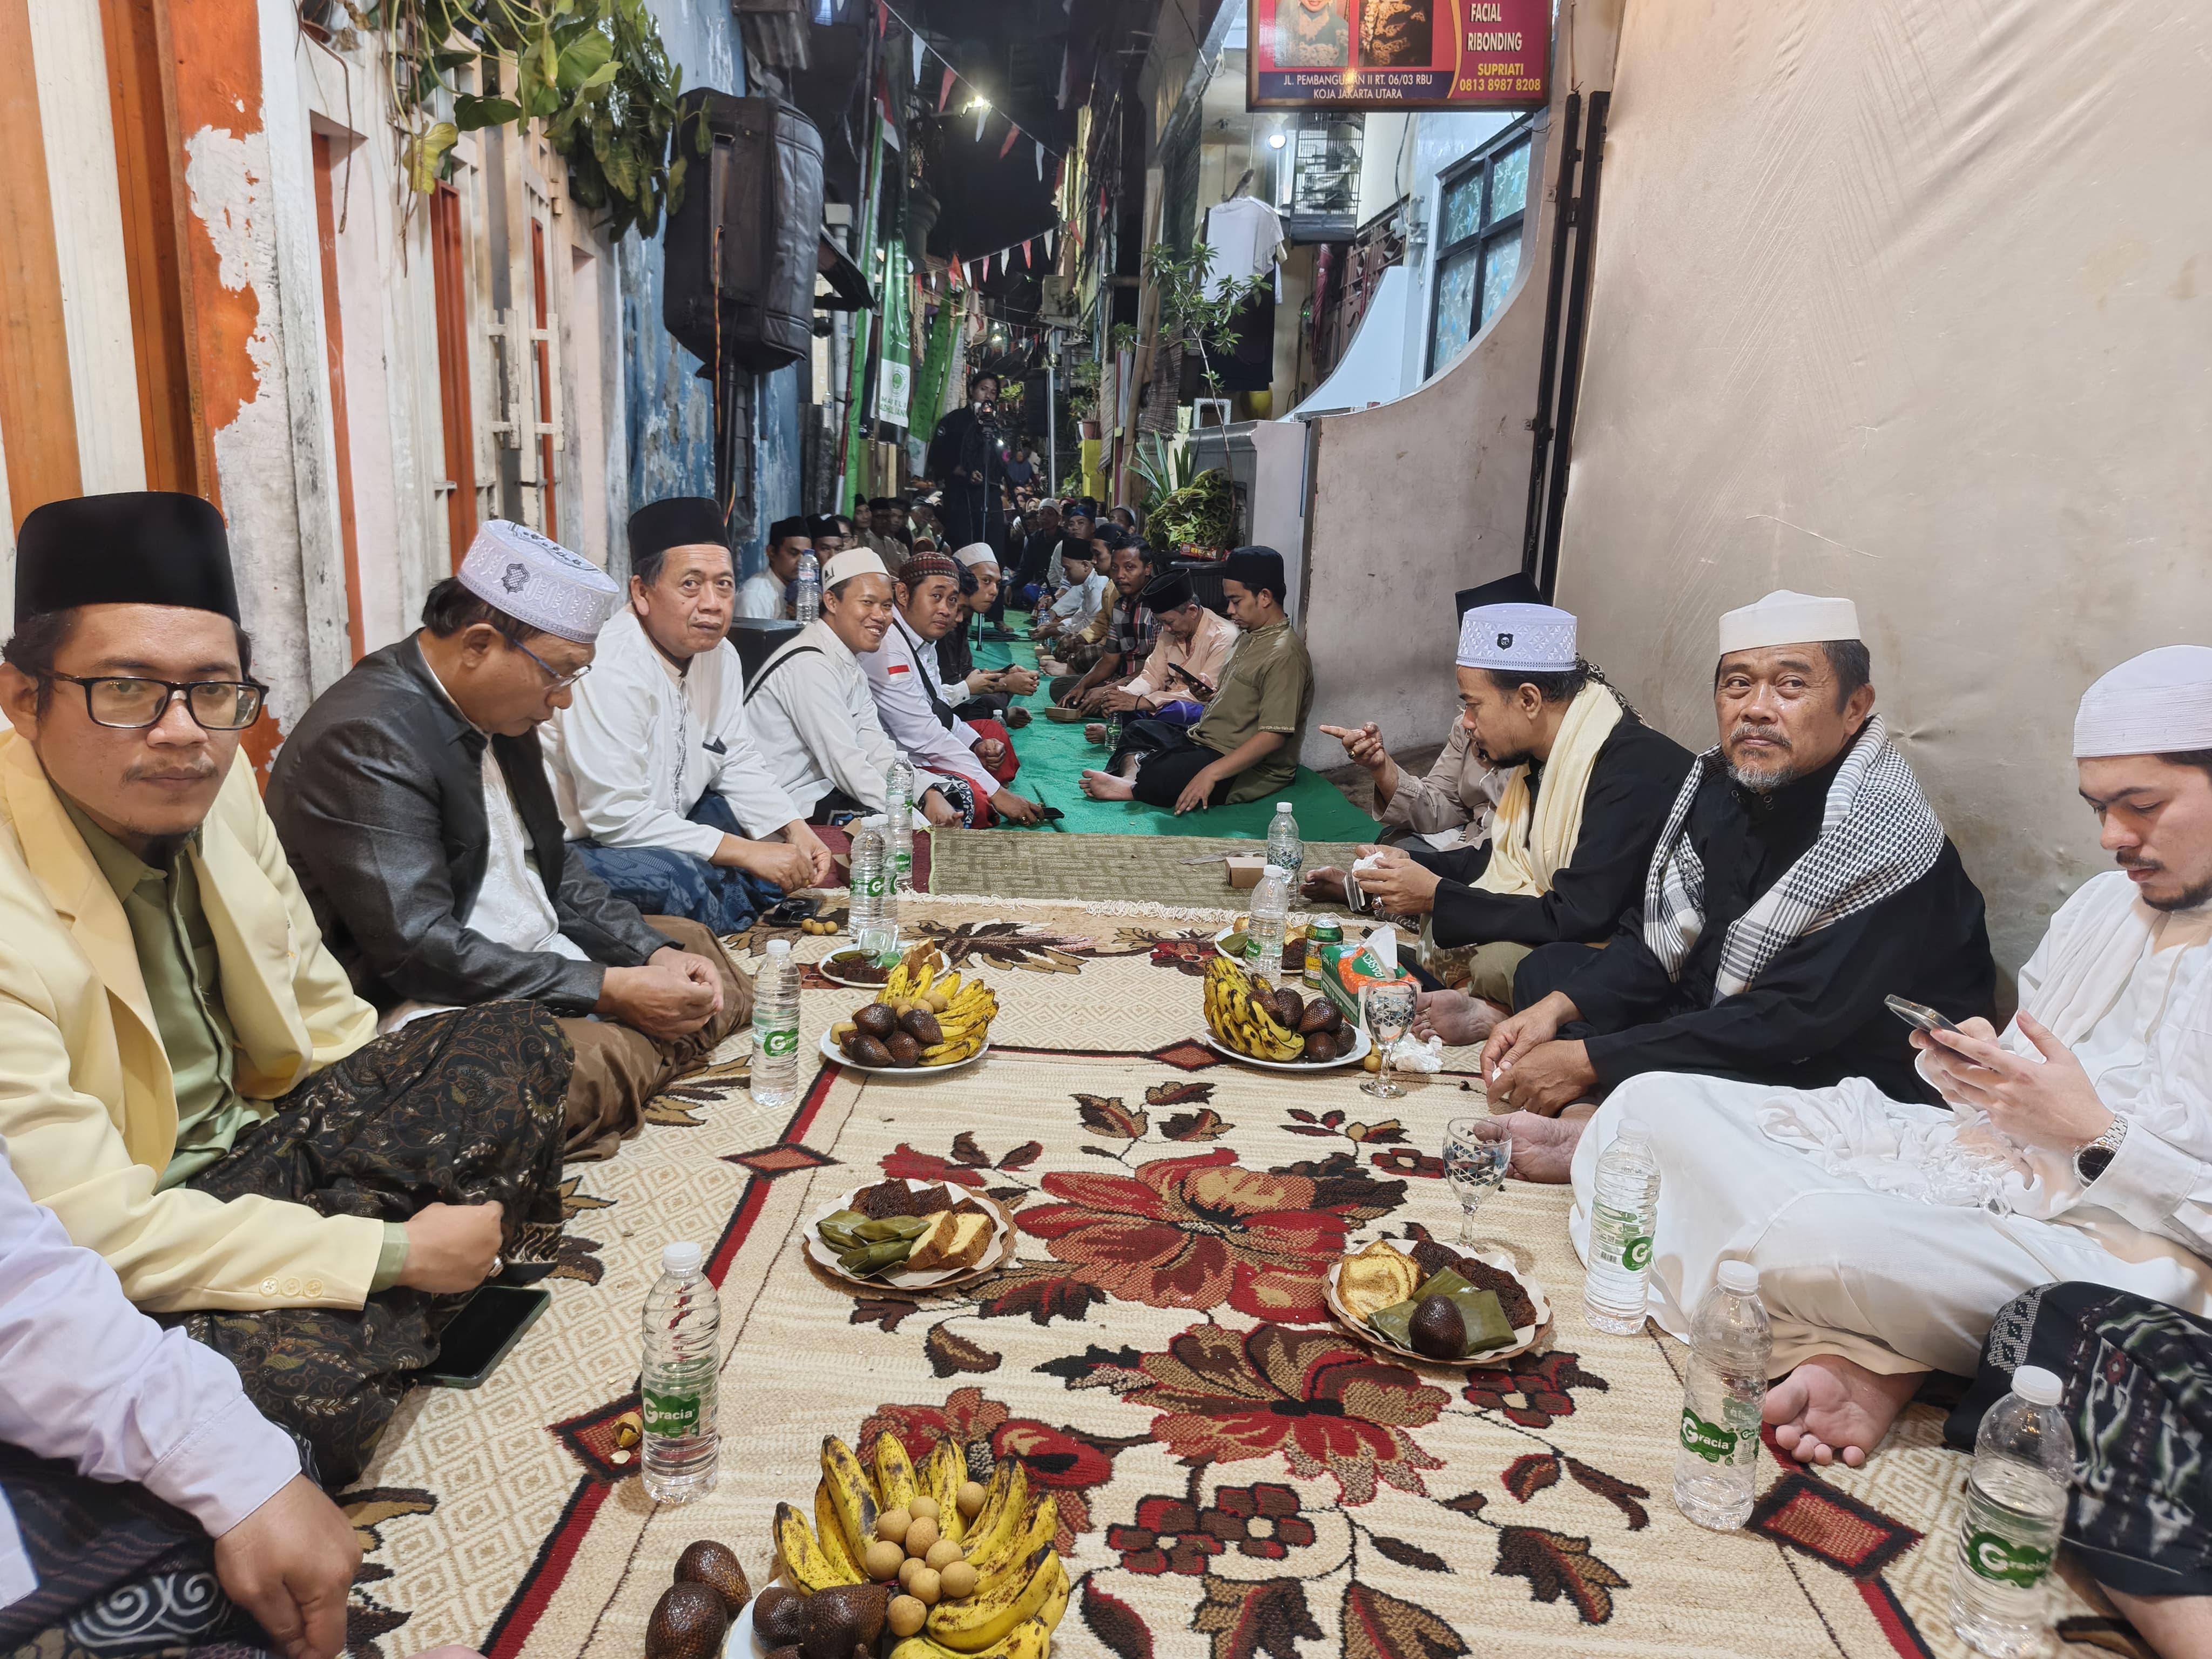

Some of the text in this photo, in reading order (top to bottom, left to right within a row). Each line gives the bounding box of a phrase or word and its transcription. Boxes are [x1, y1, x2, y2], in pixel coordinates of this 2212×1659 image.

[1470, 3, 1502, 22] FACIAL
[1467, 32, 1522, 51] RIBONDING
[1478, 63, 1523, 76] SUPRIATI
[1284, 75, 1294, 85] JL.
[1367, 75, 1373, 85] II
[1375, 75, 1386, 85] RT.
[1388, 75, 1413, 86] 06/03
[1416, 75, 1432, 85] RBU
[1460, 78, 1541, 91] 0813 8987 8208
[1313, 89, 1402, 99] KOJA JAKARTA UTARA
[643, 1397, 694, 1424] Gracia
[1682, 1417, 1729, 1449] Gracia
